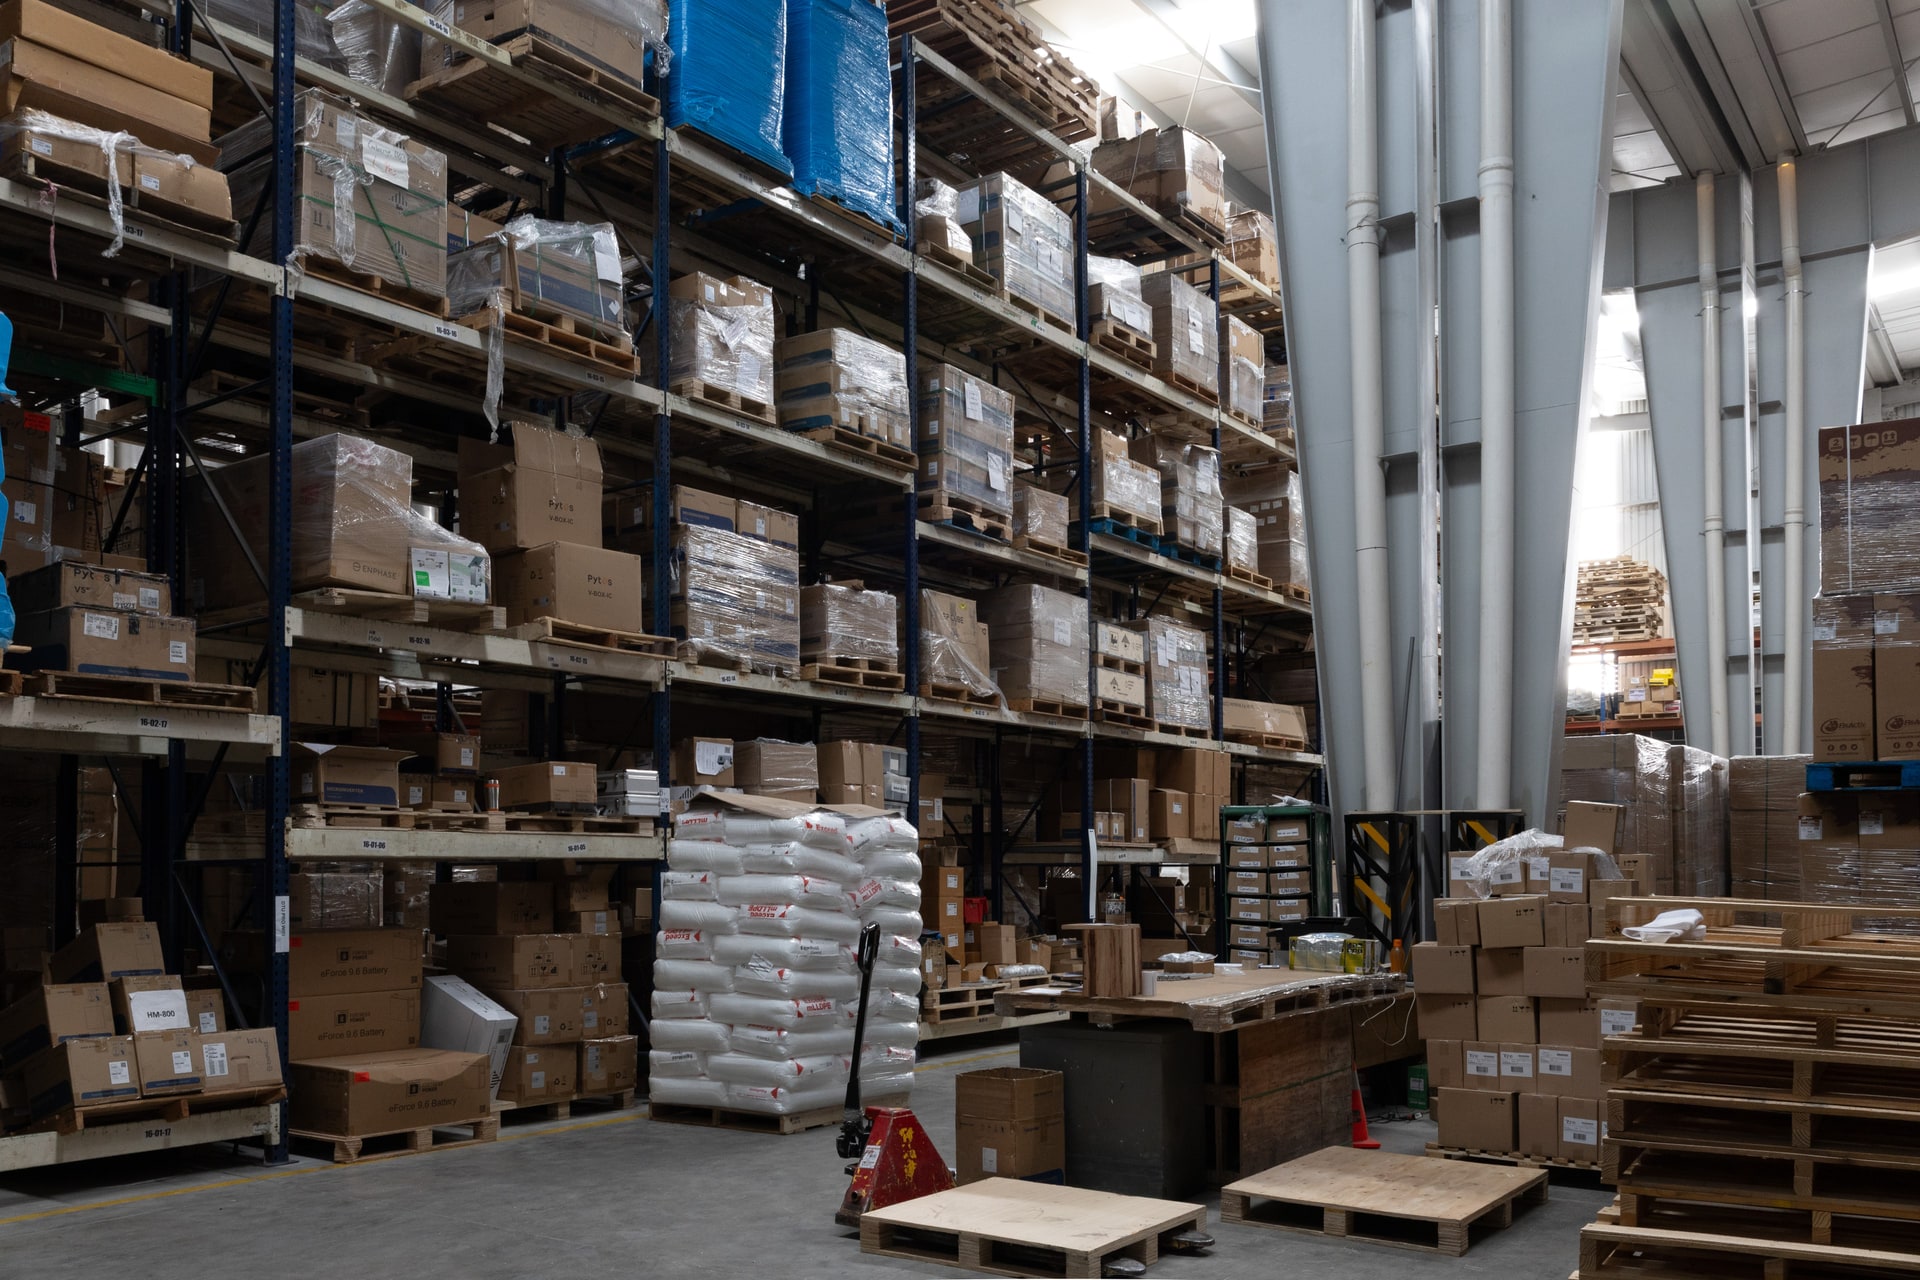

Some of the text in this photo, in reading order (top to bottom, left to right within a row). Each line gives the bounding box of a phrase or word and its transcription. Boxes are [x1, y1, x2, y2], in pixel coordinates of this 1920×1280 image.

[435, 326, 458, 338] 16-03-16
[362, 565, 398, 580] ENPHASE
[140, 718, 168, 728] 16-02-17
[363, 840, 386, 849] 16-01-06
[665, 933, 691, 941] Exceed
[320, 966, 389, 978] eForce 9.6 Battery
[146, 1010, 175, 1018] HM-800
[318, 1028, 386, 1041] eForce 9.6 Battery
[388, 1098, 458, 1113] eForce 9.6 Battery
[145, 1128, 171, 1137] 16-01-17
